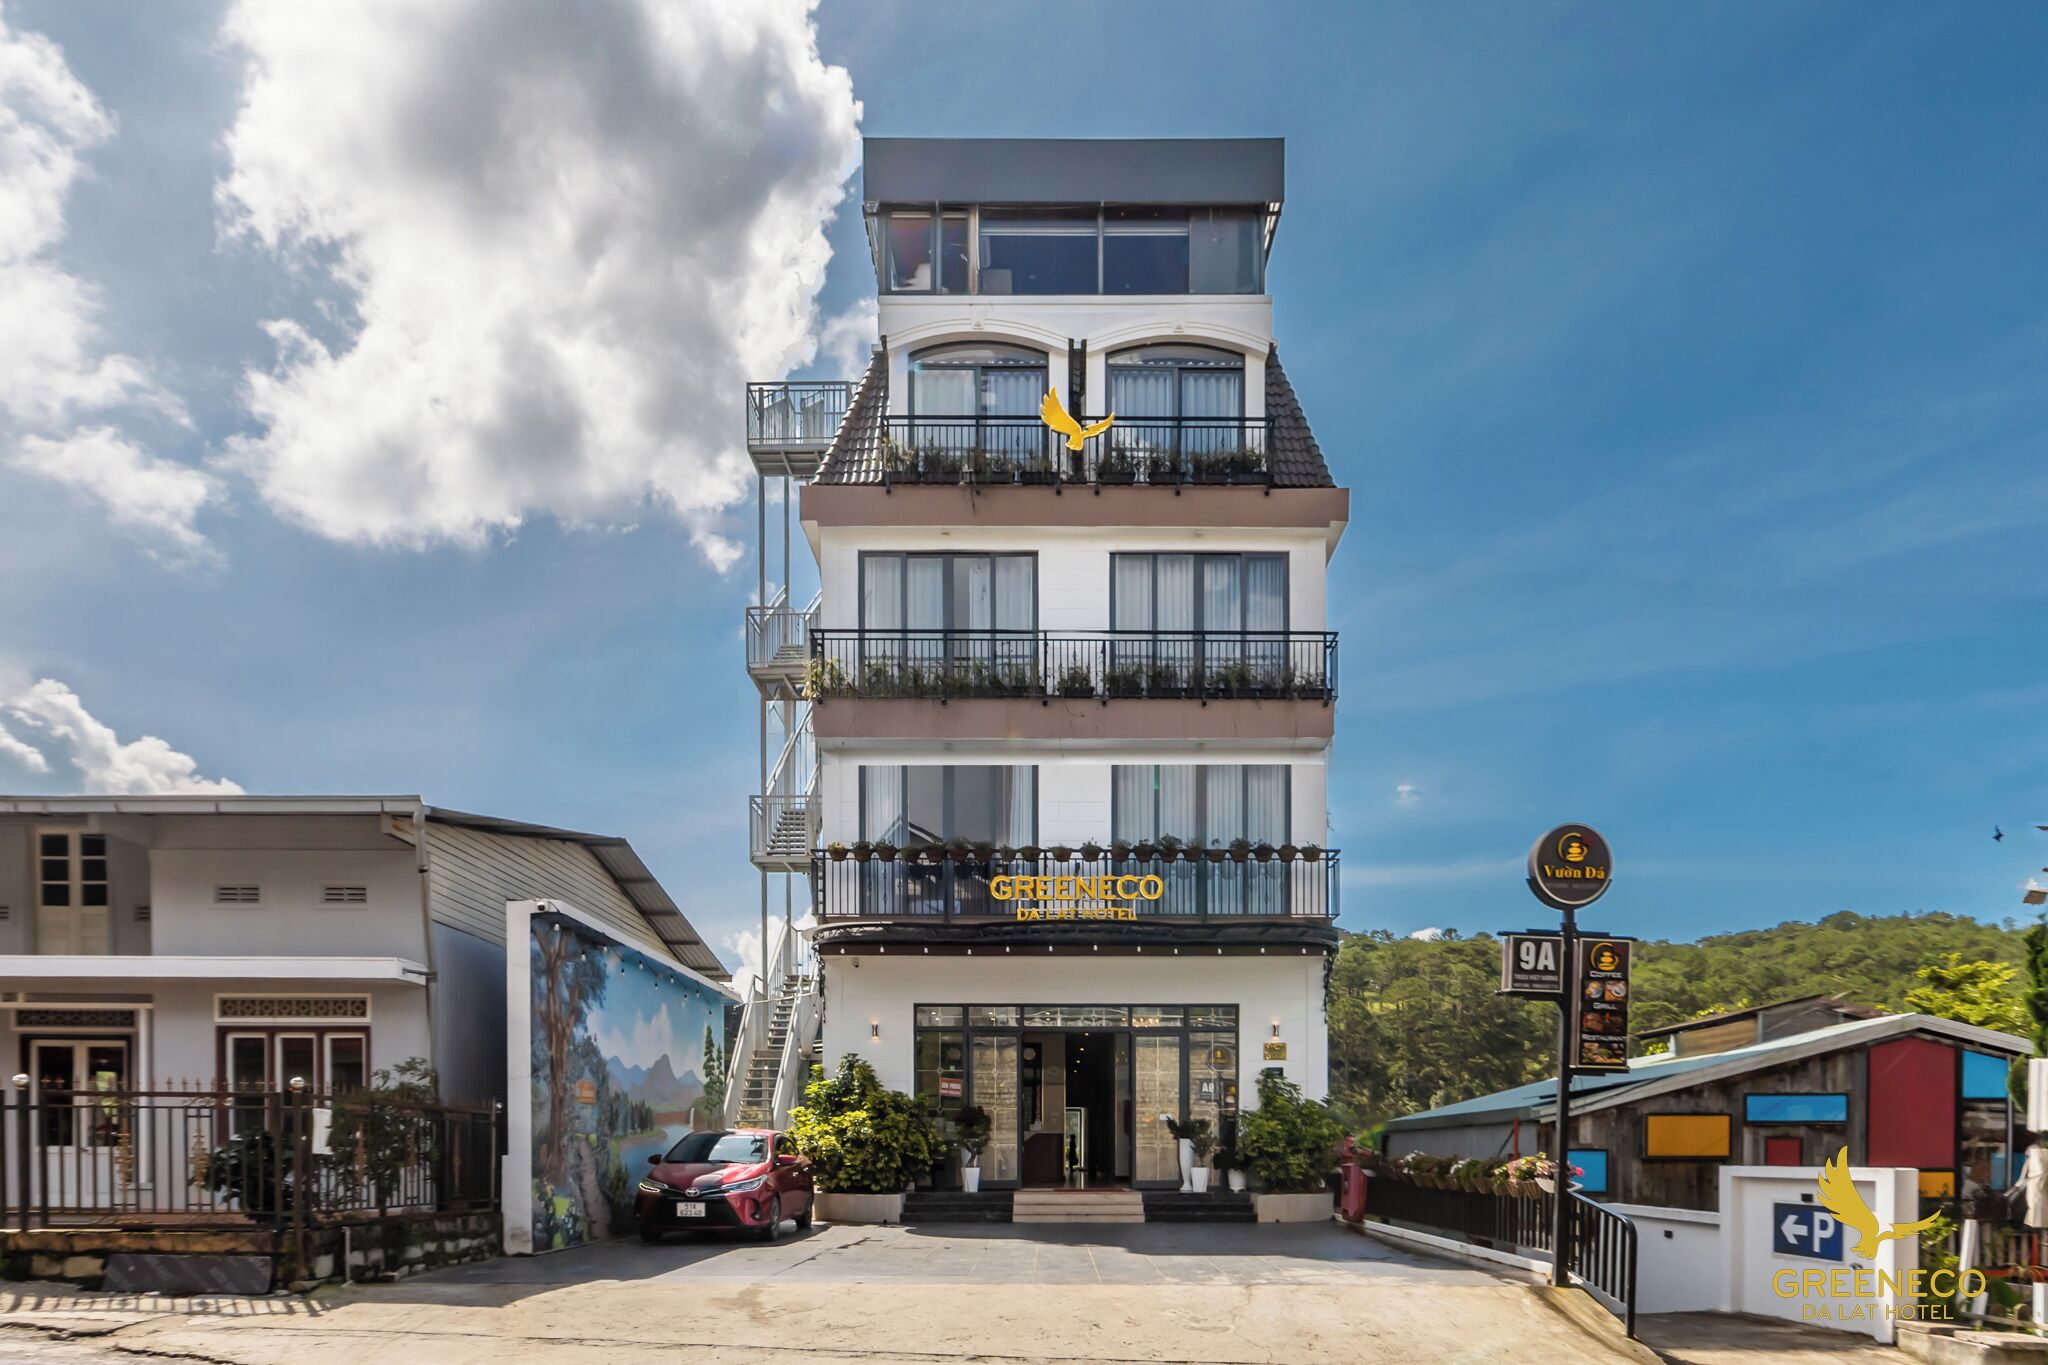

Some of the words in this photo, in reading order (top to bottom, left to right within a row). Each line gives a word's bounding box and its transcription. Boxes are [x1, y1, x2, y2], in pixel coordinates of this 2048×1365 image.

[1585, 866, 1605, 879] Đá
[990, 874, 1164, 901] GREENECO
[1017, 908, 1040, 921] DA
[1046, 908, 1075, 920] LAT
[1084, 908, 1137, 921] HOTEL
[1520, 941, 1556, 971] 9A
[1590, 971, 1623, 979] COFFEE
[1593, 1002, 1617, 1010] GRILL
[1582, 1034, 1626, 1042] RESTAURANT
[1813, 1211, 1836, 1253] P
